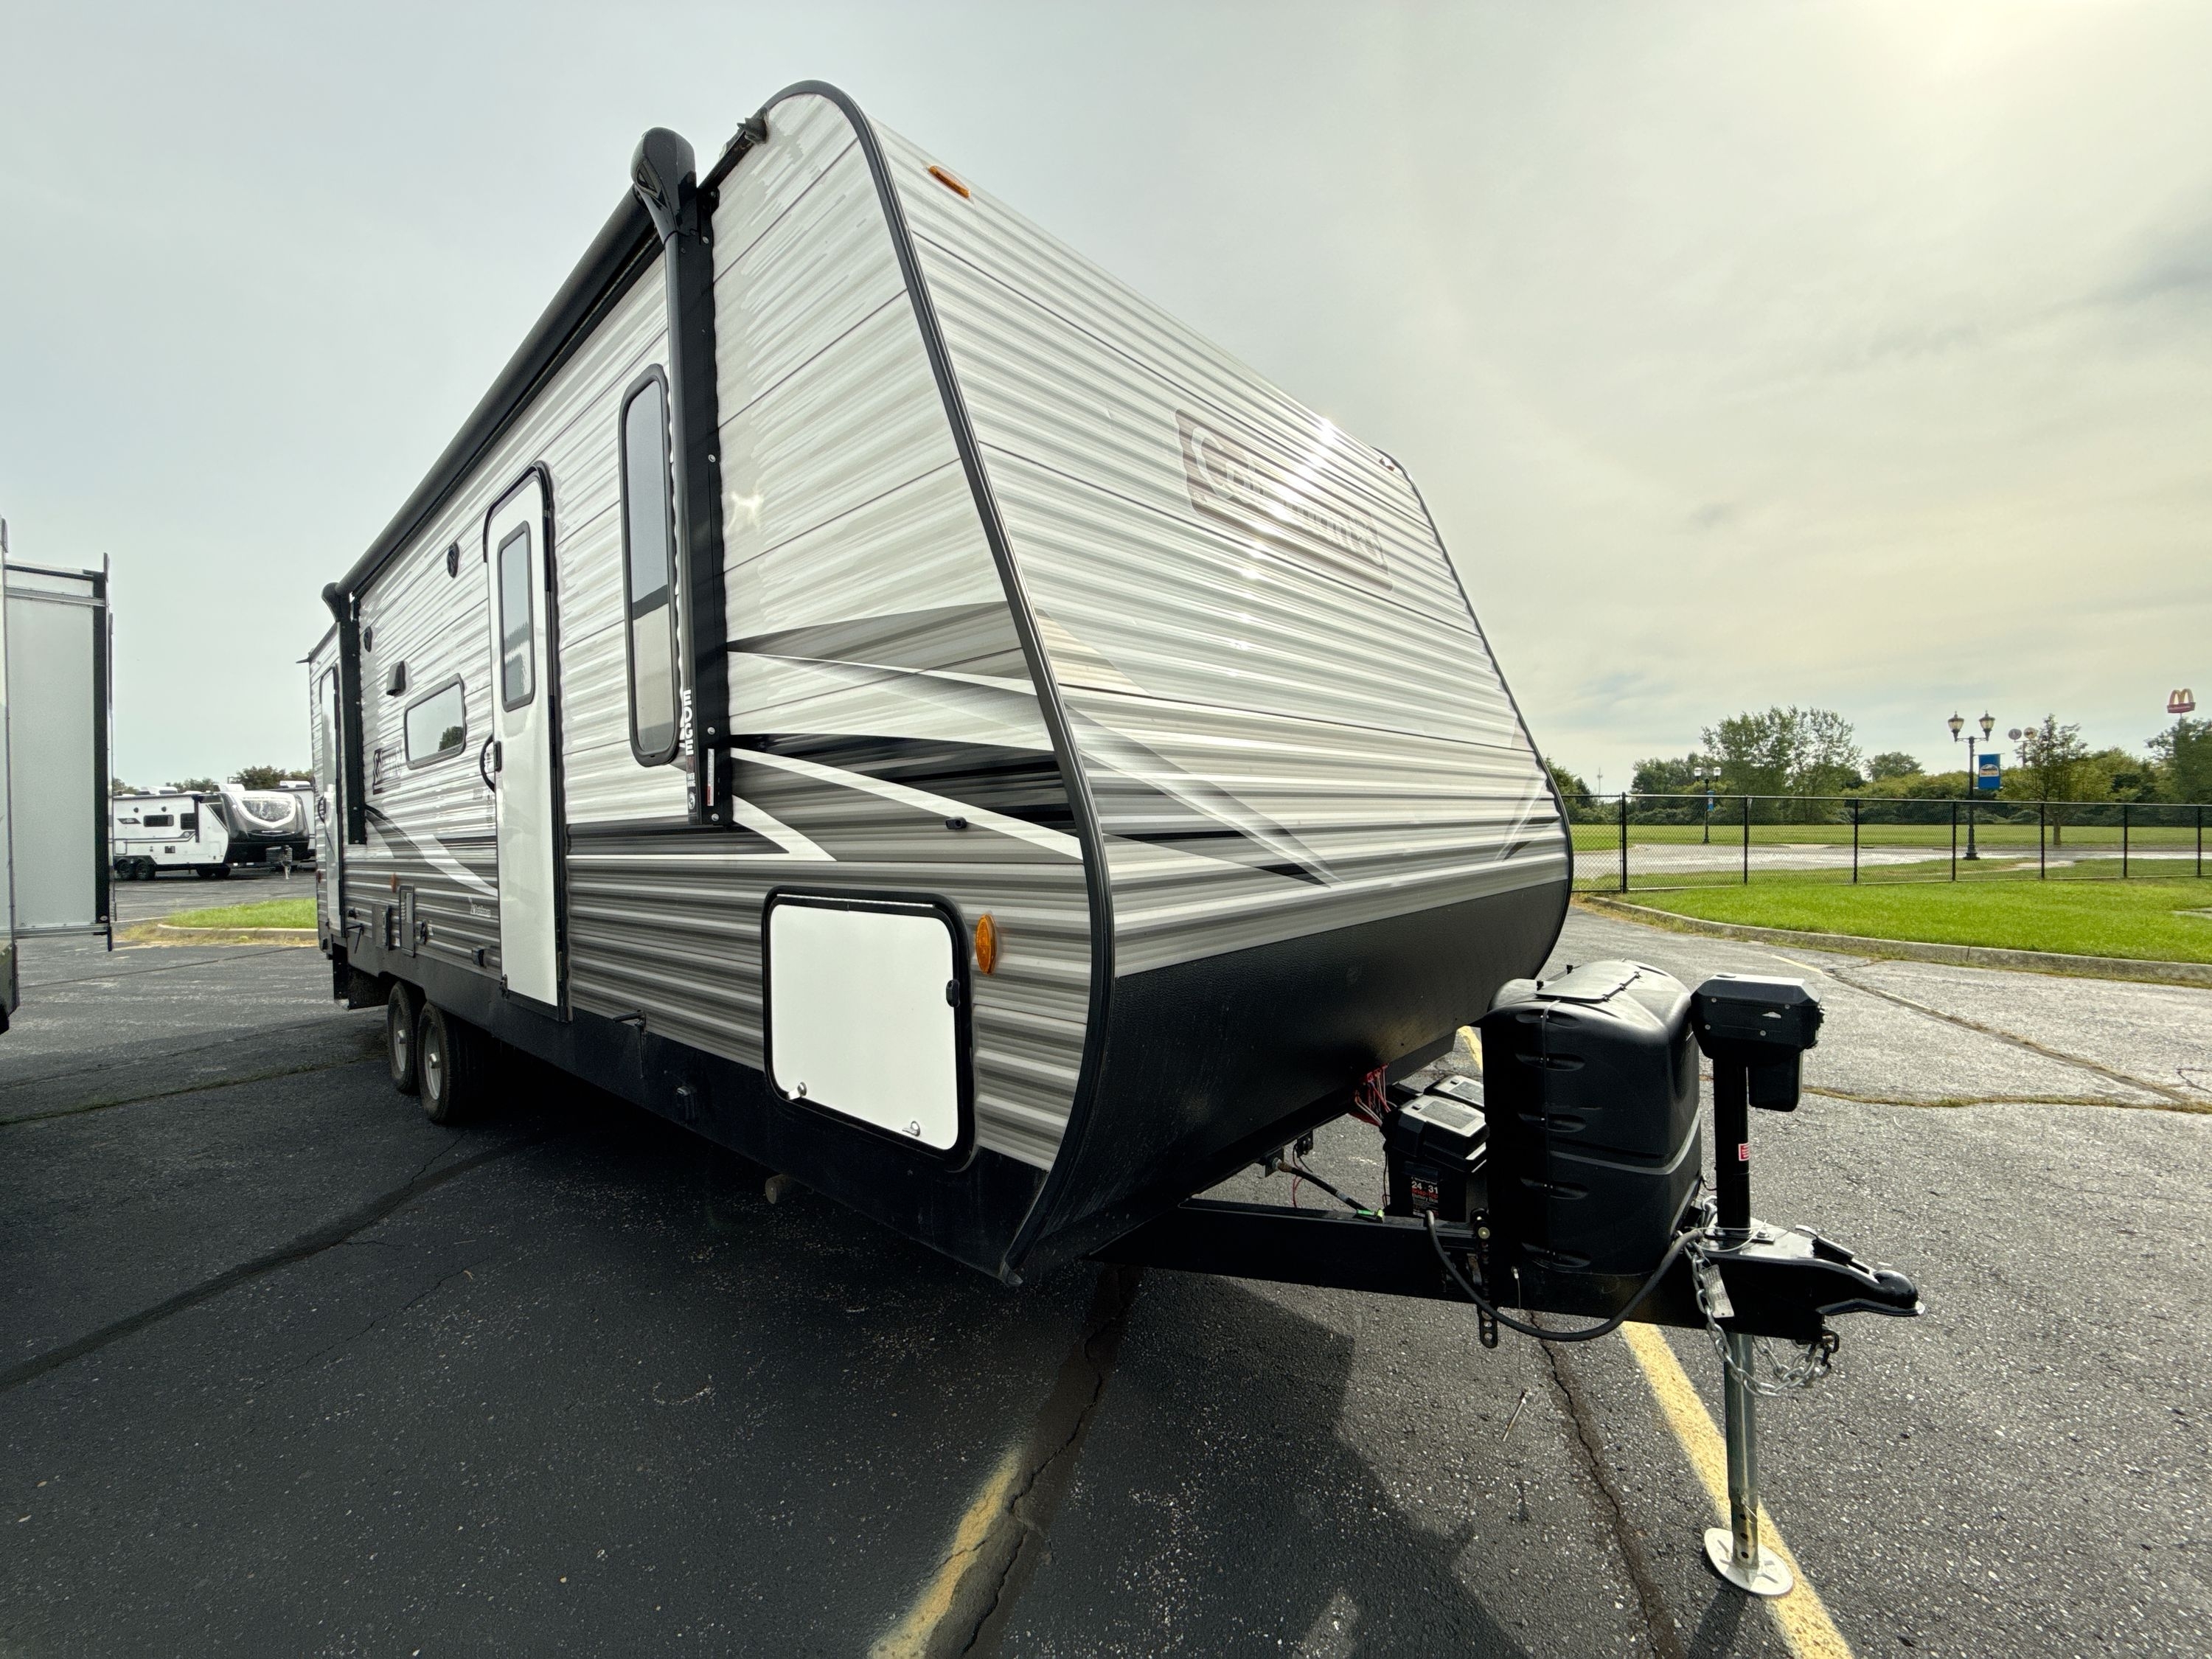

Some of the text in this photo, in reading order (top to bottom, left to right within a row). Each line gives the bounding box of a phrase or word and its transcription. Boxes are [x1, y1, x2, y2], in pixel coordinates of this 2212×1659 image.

[683, 689, 694, 756] EDGE
[1411, 1180, 1422, 1190] 24
[1427, 1185, 1439, 1194] 31
